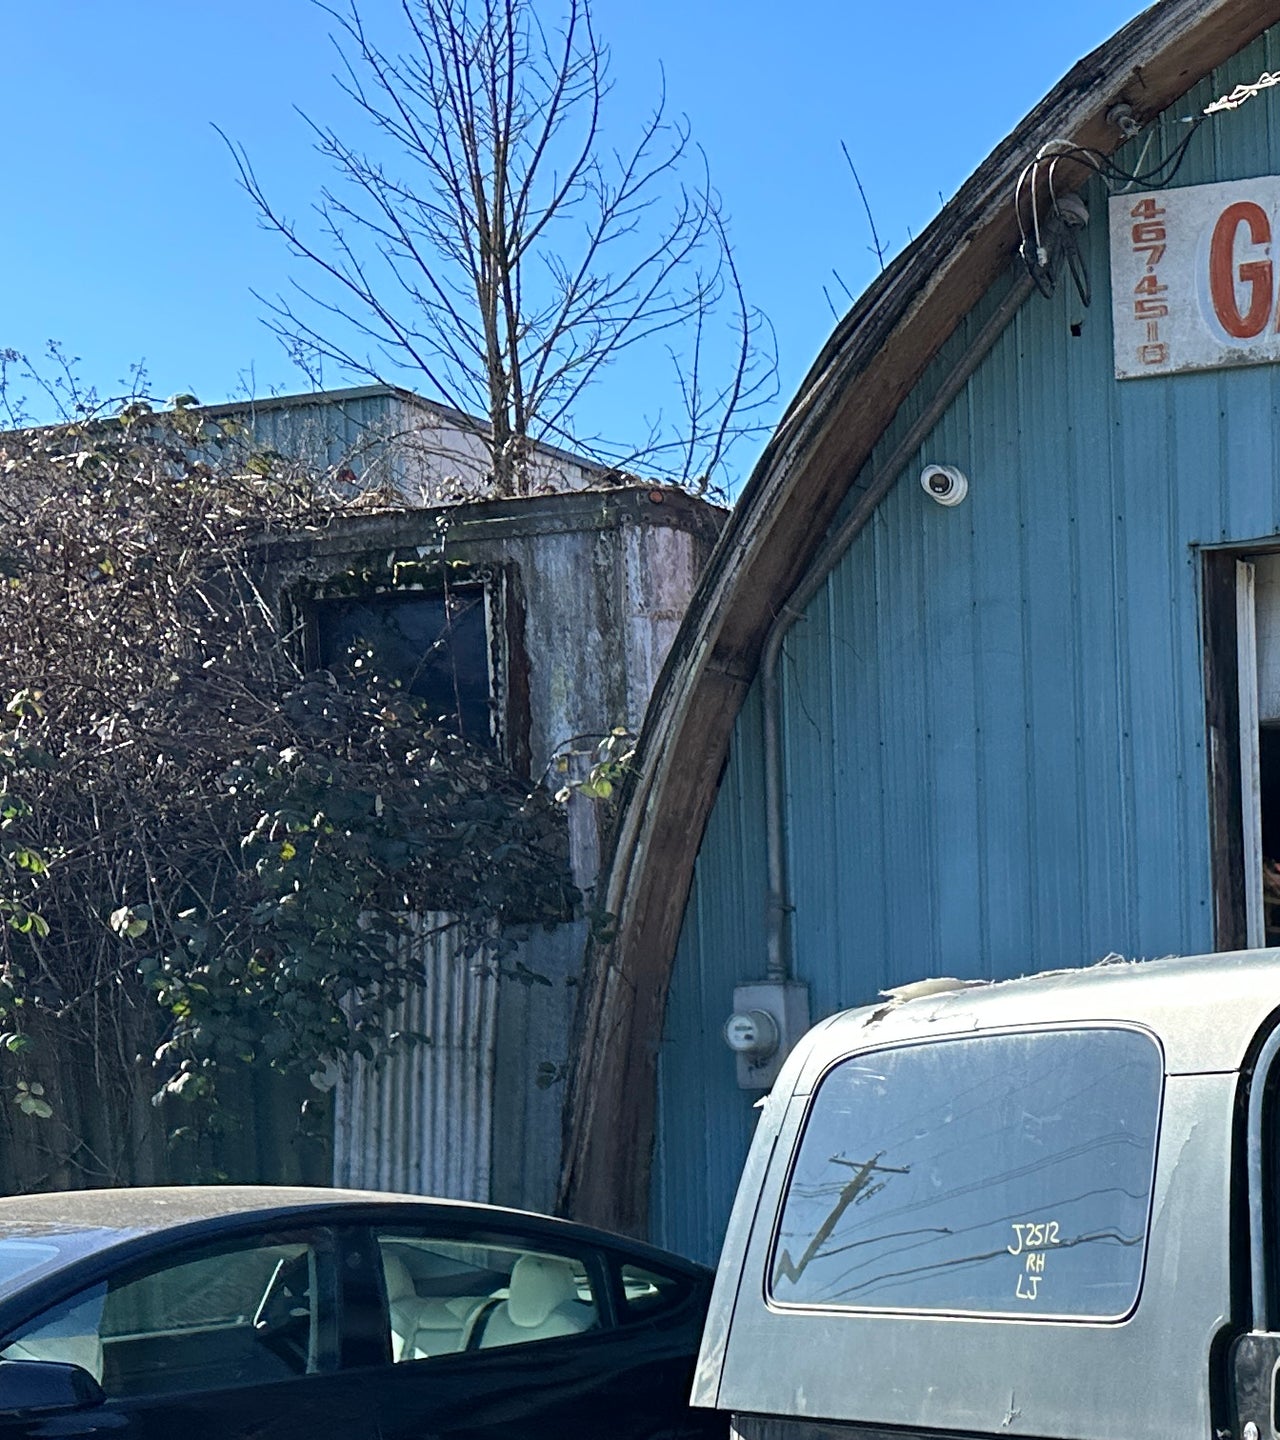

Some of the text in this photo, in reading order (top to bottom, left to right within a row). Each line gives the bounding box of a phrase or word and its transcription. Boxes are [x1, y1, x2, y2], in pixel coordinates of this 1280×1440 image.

[1007, 1221, 1060, 1256] J2512
[1025, 1253, 1046, 1273] RH
[1016, 1274, 1042, 1300] LJ
